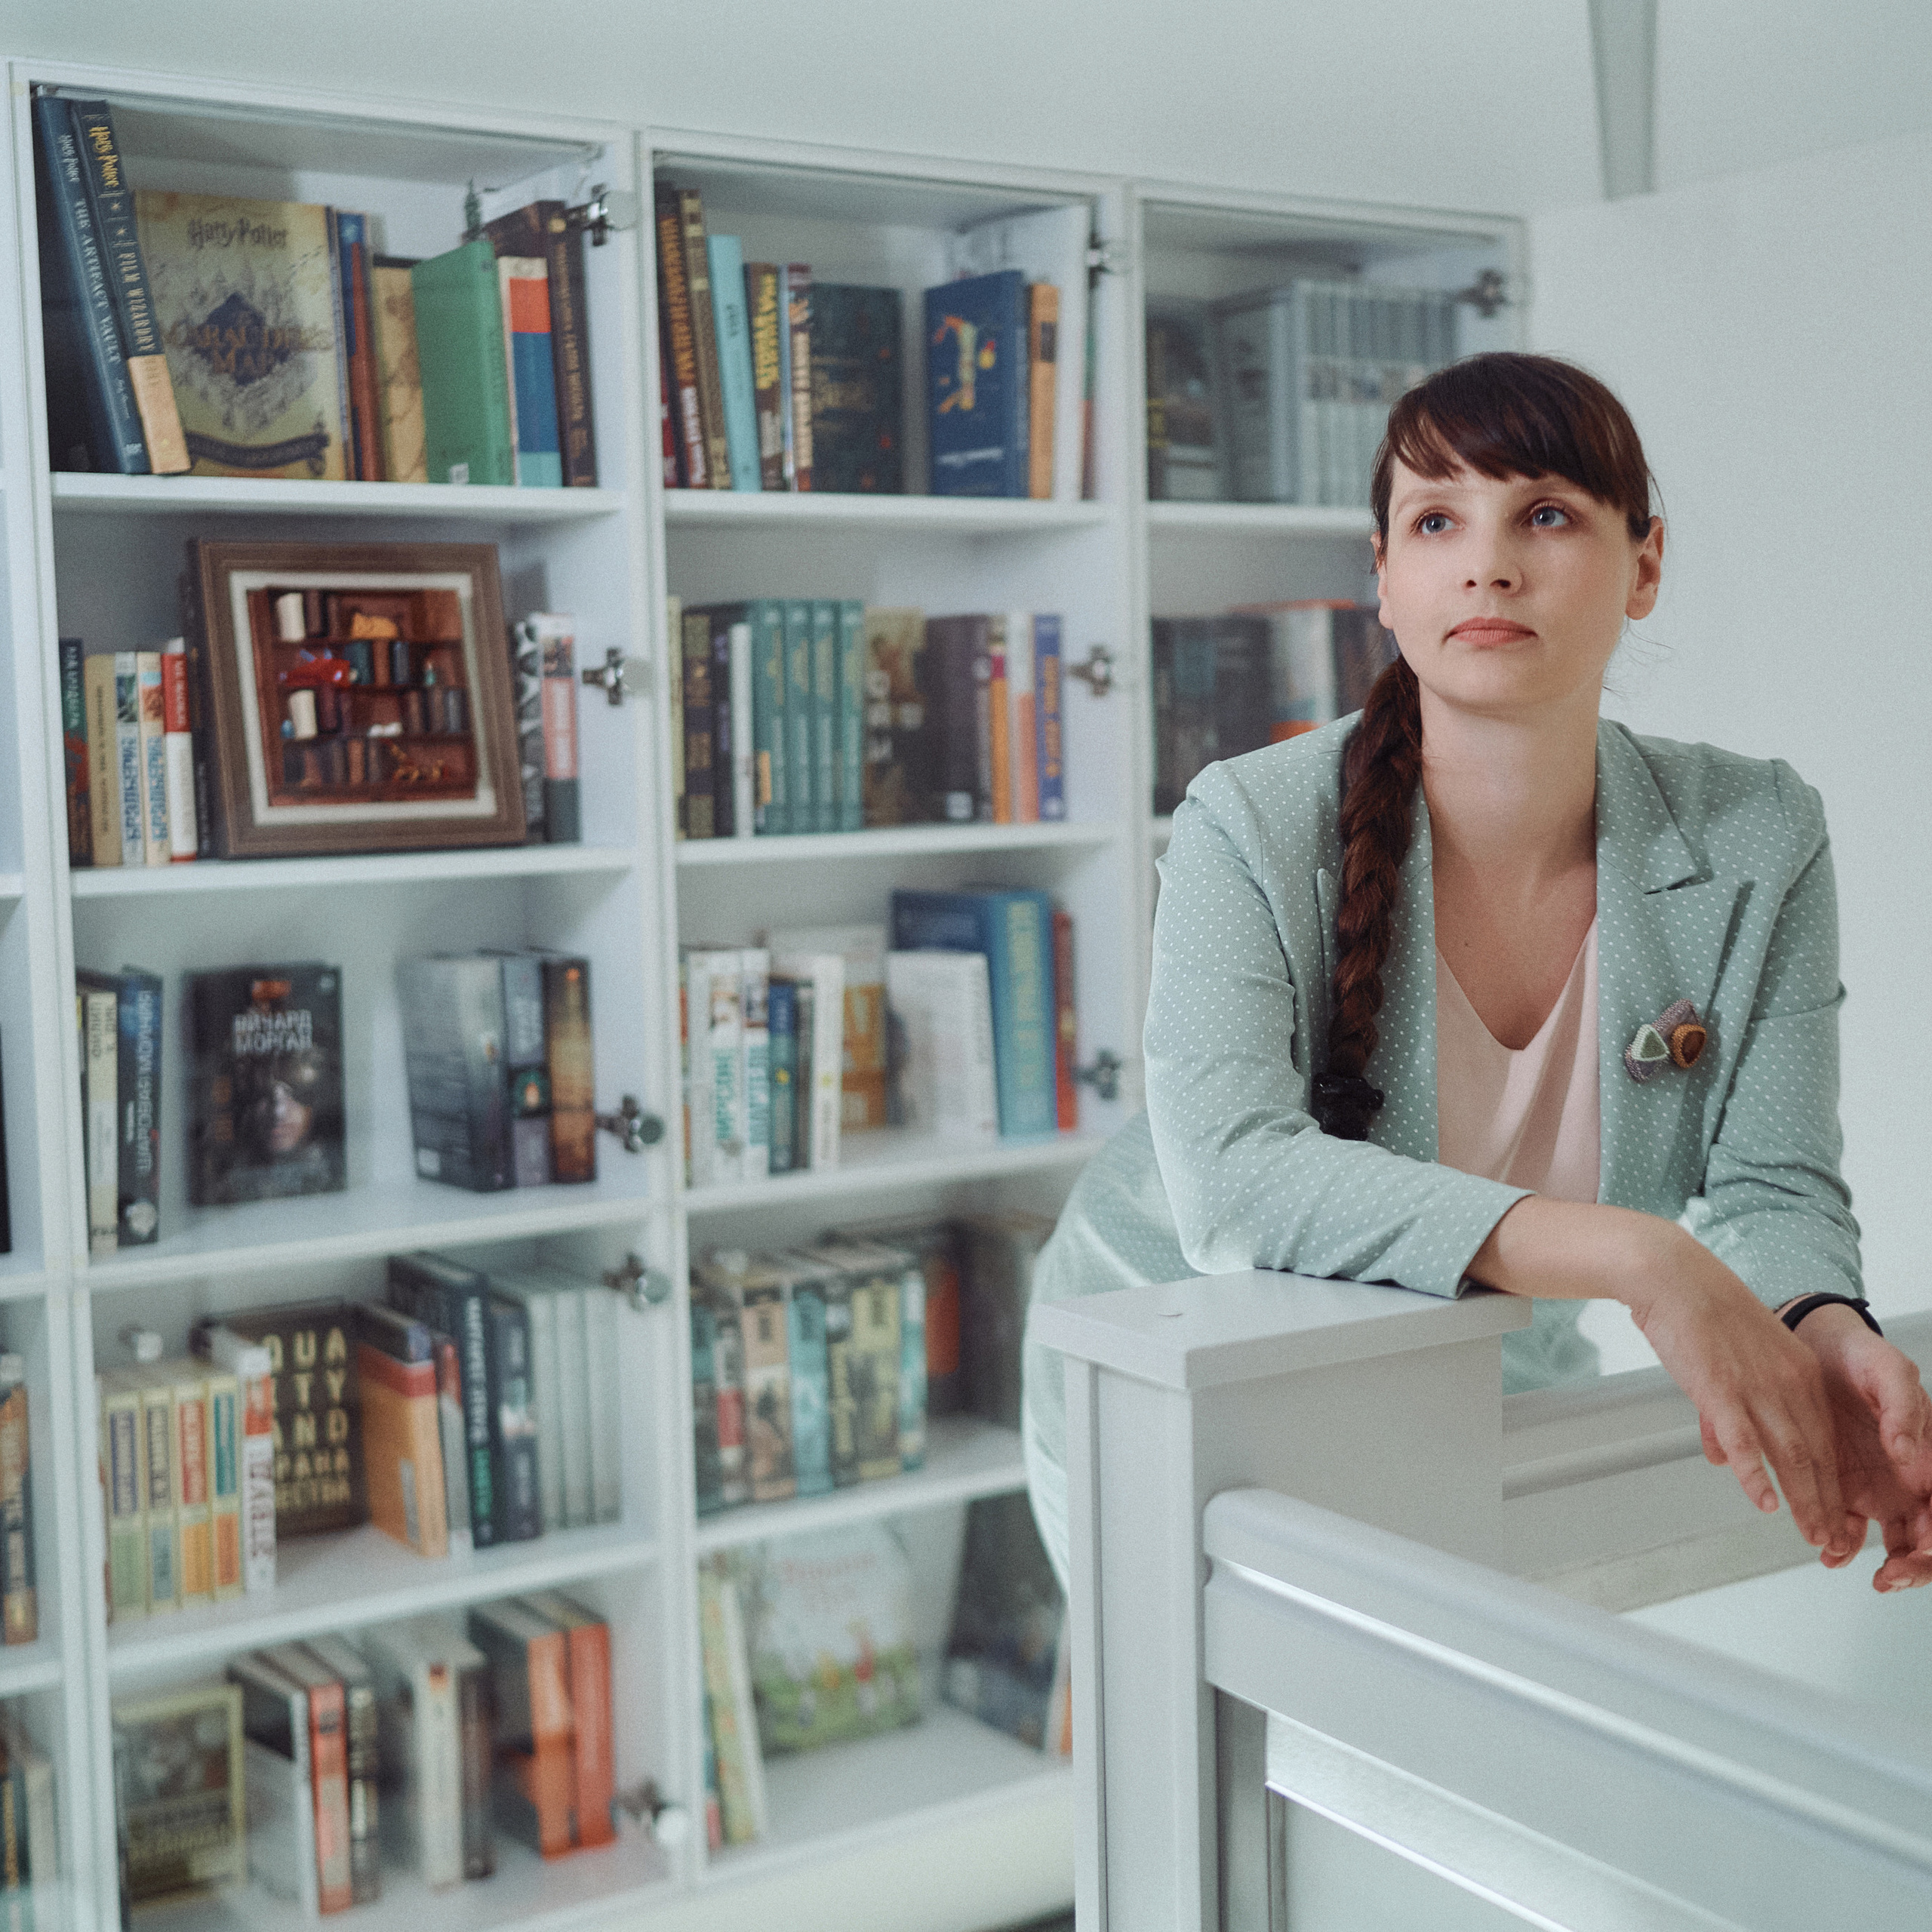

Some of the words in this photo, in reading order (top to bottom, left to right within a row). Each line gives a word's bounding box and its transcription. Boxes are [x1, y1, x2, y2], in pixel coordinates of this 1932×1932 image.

[89, 126, 113, 154] Harry
[95, 155, 119, 187] Potter
[75, 198, 91, 228] THE
[189, 219, 235, 251] Harry
[236, 217, 288, 251] Potter
[82, 234, 109, 309] ARTIFACT
[118, 253, 141, 284] FILM
[126, 288, 156, 352] WIZARDRY
